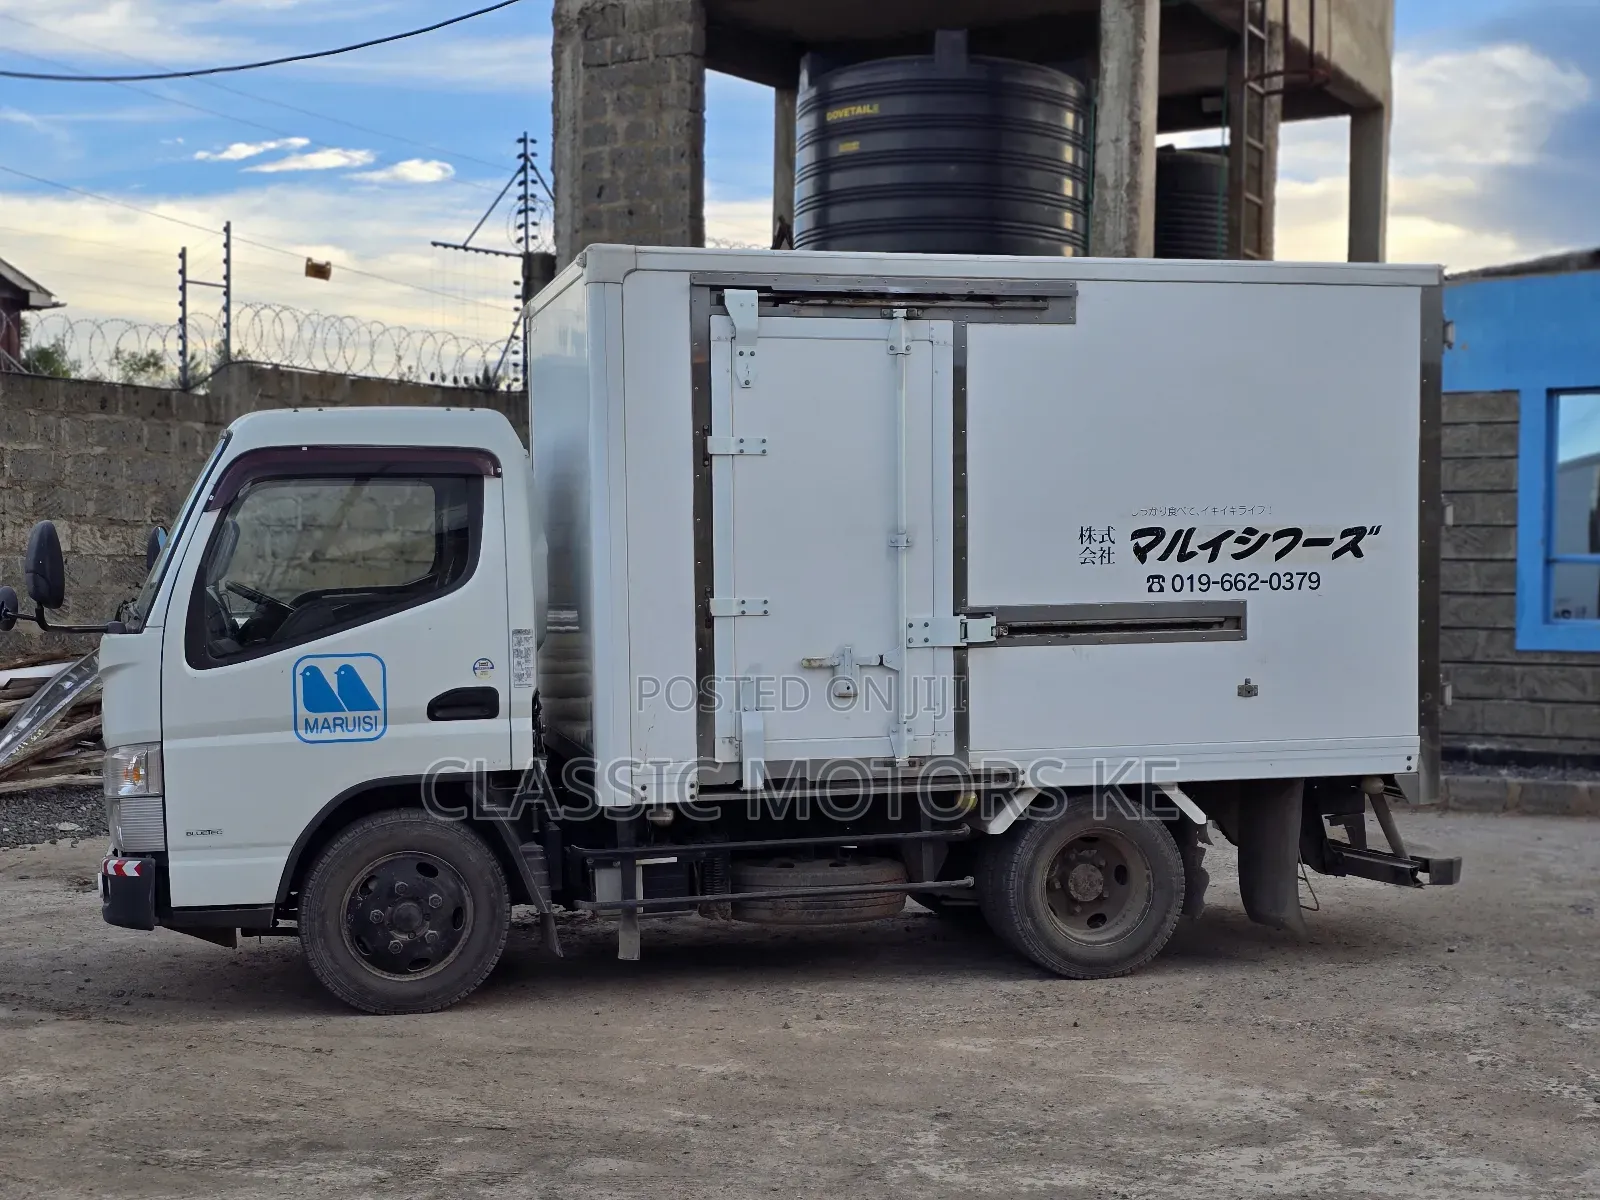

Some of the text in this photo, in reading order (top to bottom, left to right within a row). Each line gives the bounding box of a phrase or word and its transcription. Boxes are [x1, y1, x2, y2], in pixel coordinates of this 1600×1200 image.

[1078, 525, 1116, 546] 株式
[1130, 524, 1383, 565] マルイシフーズ
[1078, 546, 1116, 566] 会社
[1171, 571, 1321, 593] 019-662-0379
[304, 715, 378, 735] MARUISI
